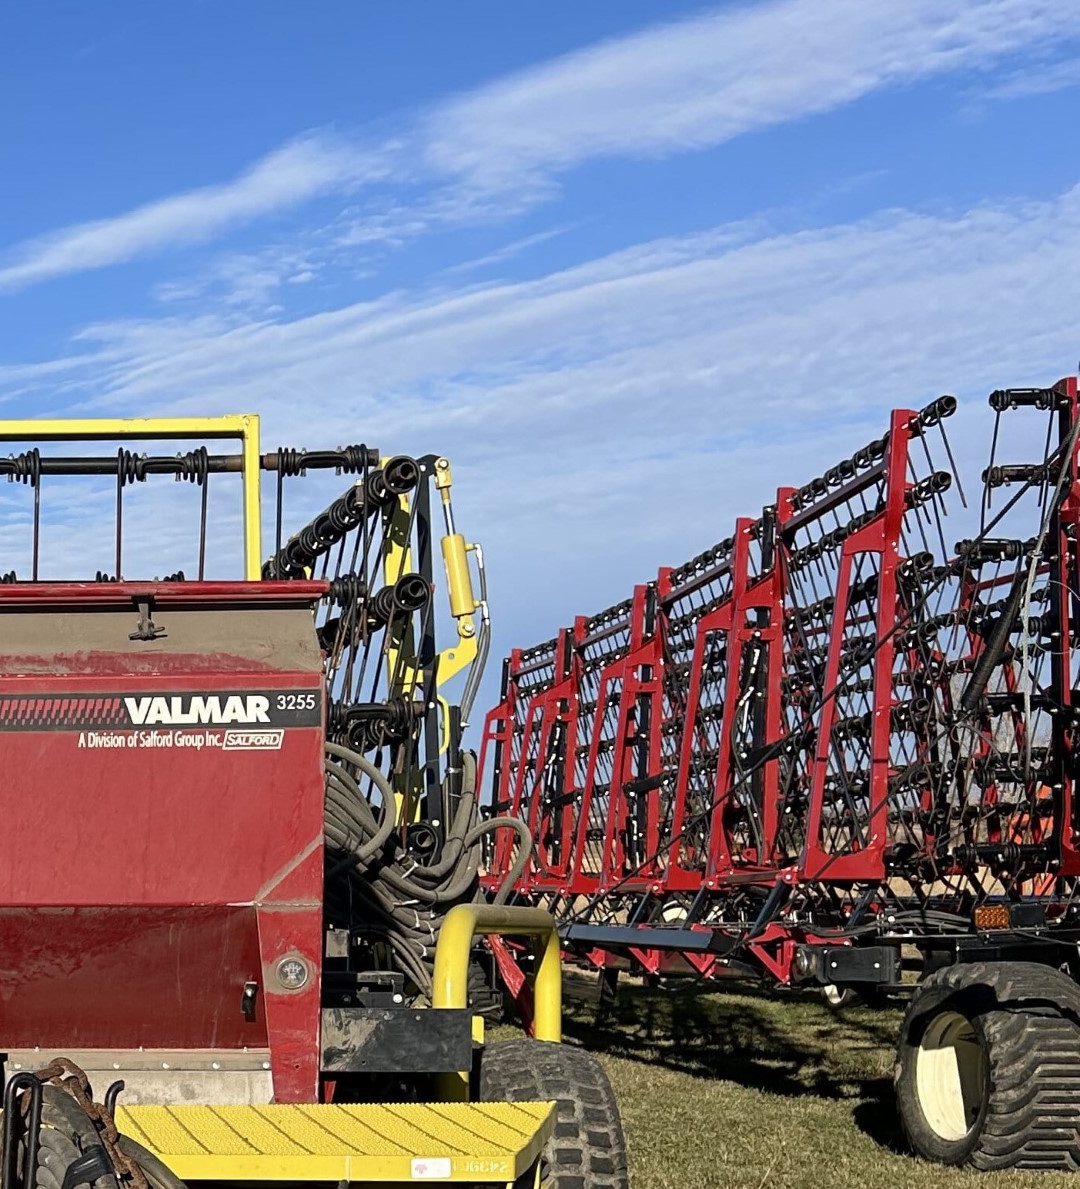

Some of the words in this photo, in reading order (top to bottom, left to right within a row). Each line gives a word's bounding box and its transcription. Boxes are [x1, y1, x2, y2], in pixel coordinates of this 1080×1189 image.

[124, 696, 271, 725] VALMAR
[276, 695, 315, 710] 3255
[78, 732, 86, 748] A
[88, 732, 125, 748] Division
[127, 731, 138, 748] of
[140, 730, 172, 748] Salford
[174, 731, 204, 751] Group
[206, 730, 222, 747] Inc.
[227, 734, 280, 746] SALFORD
